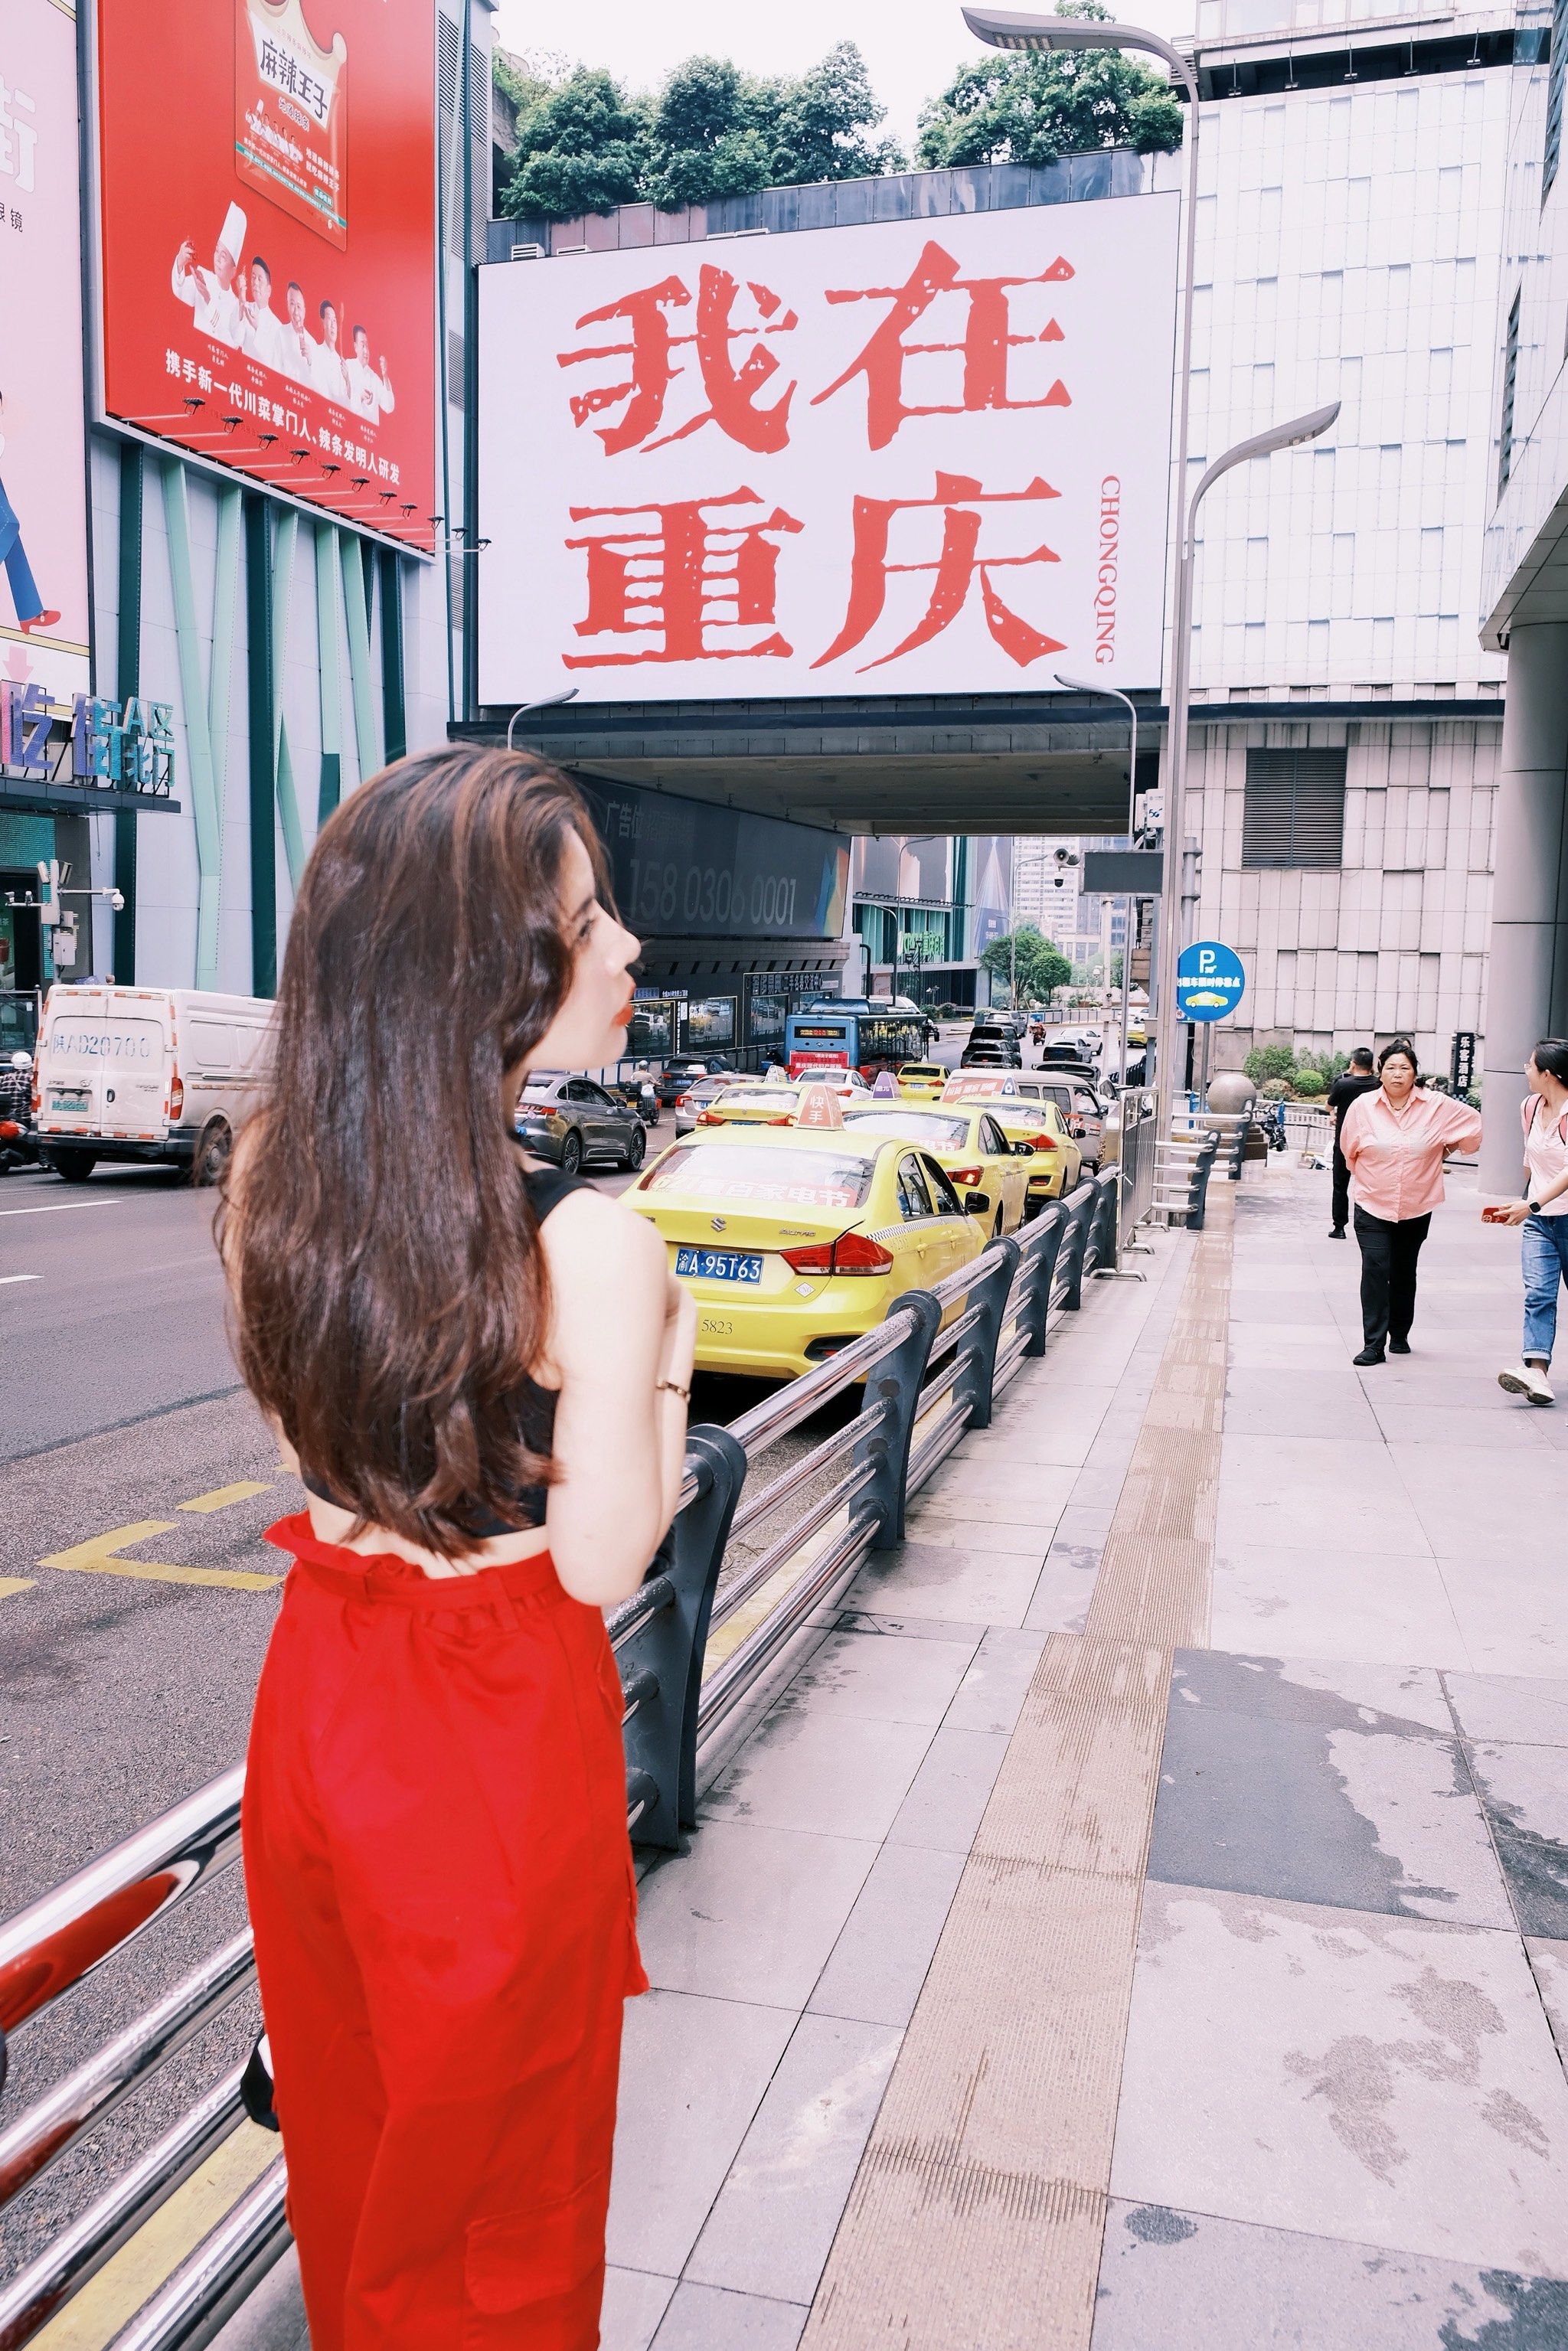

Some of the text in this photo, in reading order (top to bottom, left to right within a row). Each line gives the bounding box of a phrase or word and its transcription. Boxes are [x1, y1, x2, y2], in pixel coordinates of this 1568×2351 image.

[260, 38, 328, 119] 麻辣王子
[556, 240, 1076, 456] 我在
[166, 348, 400, 485] 携手新一代川菜掌门人、辣条发明人研发
[560, 470, 1069, 674] 重庆
[1094, 475, 1121, 665] CHONGQING
[124, 697, 175, 742] A区
[124, 744, 175, 787] 北门
[630, 858, 797, 926] 158 0306 0001
[1200, 949, 1216, 973] P
[53, 1034, 150, 1057] 陕AD20700
[1457, 1036, 1470, 1087] 乐客酒店
[808, 1096, 824, 1123] 快手
[701, 1318, 733, 1335] 5823
